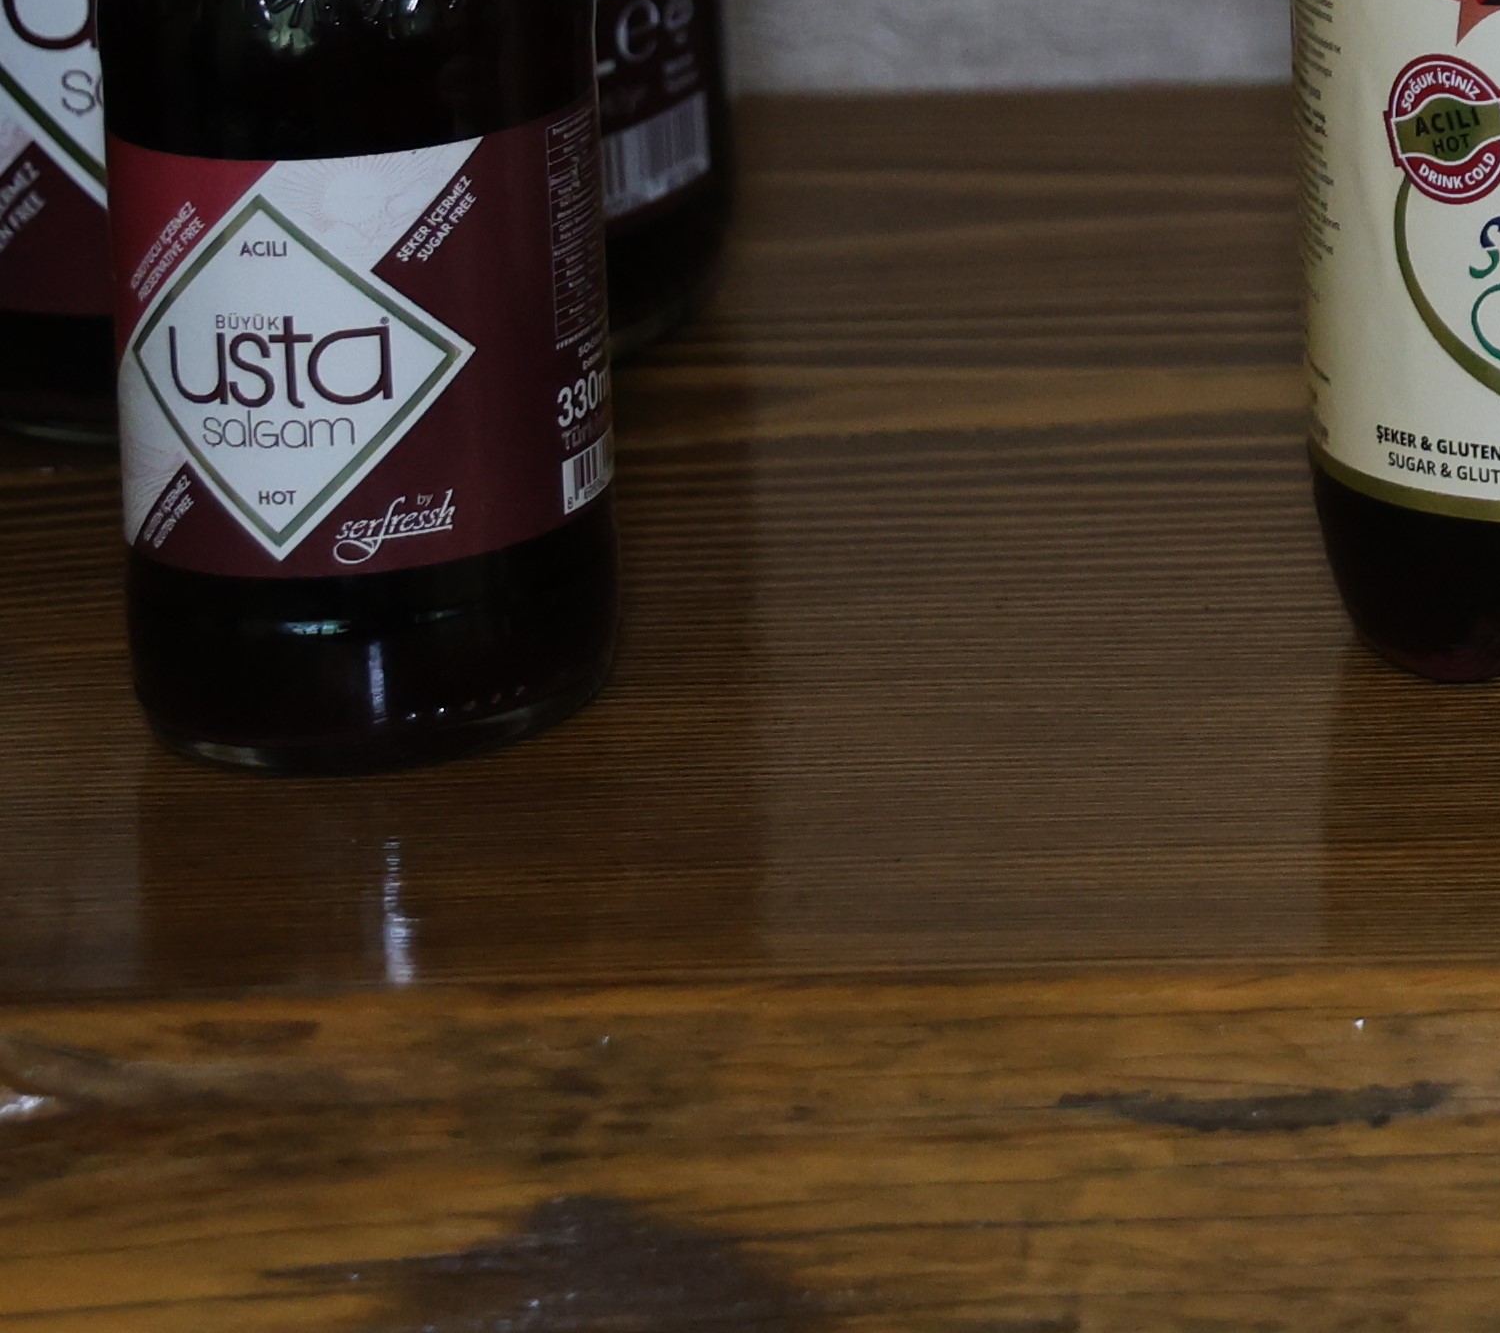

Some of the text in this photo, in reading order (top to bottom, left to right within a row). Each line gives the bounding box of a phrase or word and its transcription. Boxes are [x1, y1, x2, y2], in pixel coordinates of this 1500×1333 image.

[1401, 69, 1437, 112] SOĞUK
[1416, 106, 1480, 137] ACILI
[1432, 133, 1470, 155] HOT
[1418, 152, 1496, 189] DRINK COLD
[417, 192, 477, 262] SUGAR FREE
[239, 240, 287, 257] ACILI
[215, 314, 280, 331] BÜYÜK
[168, 315, 394, 409] usta
[1376, 424, 1417, 448] ŞEKER
[1421, 435, 1433, 451] &
[1388, 451, 1436, 476] SUGAR
[1440, 462, 1452, 478] &
[258, 490, 296, 505] HOT
